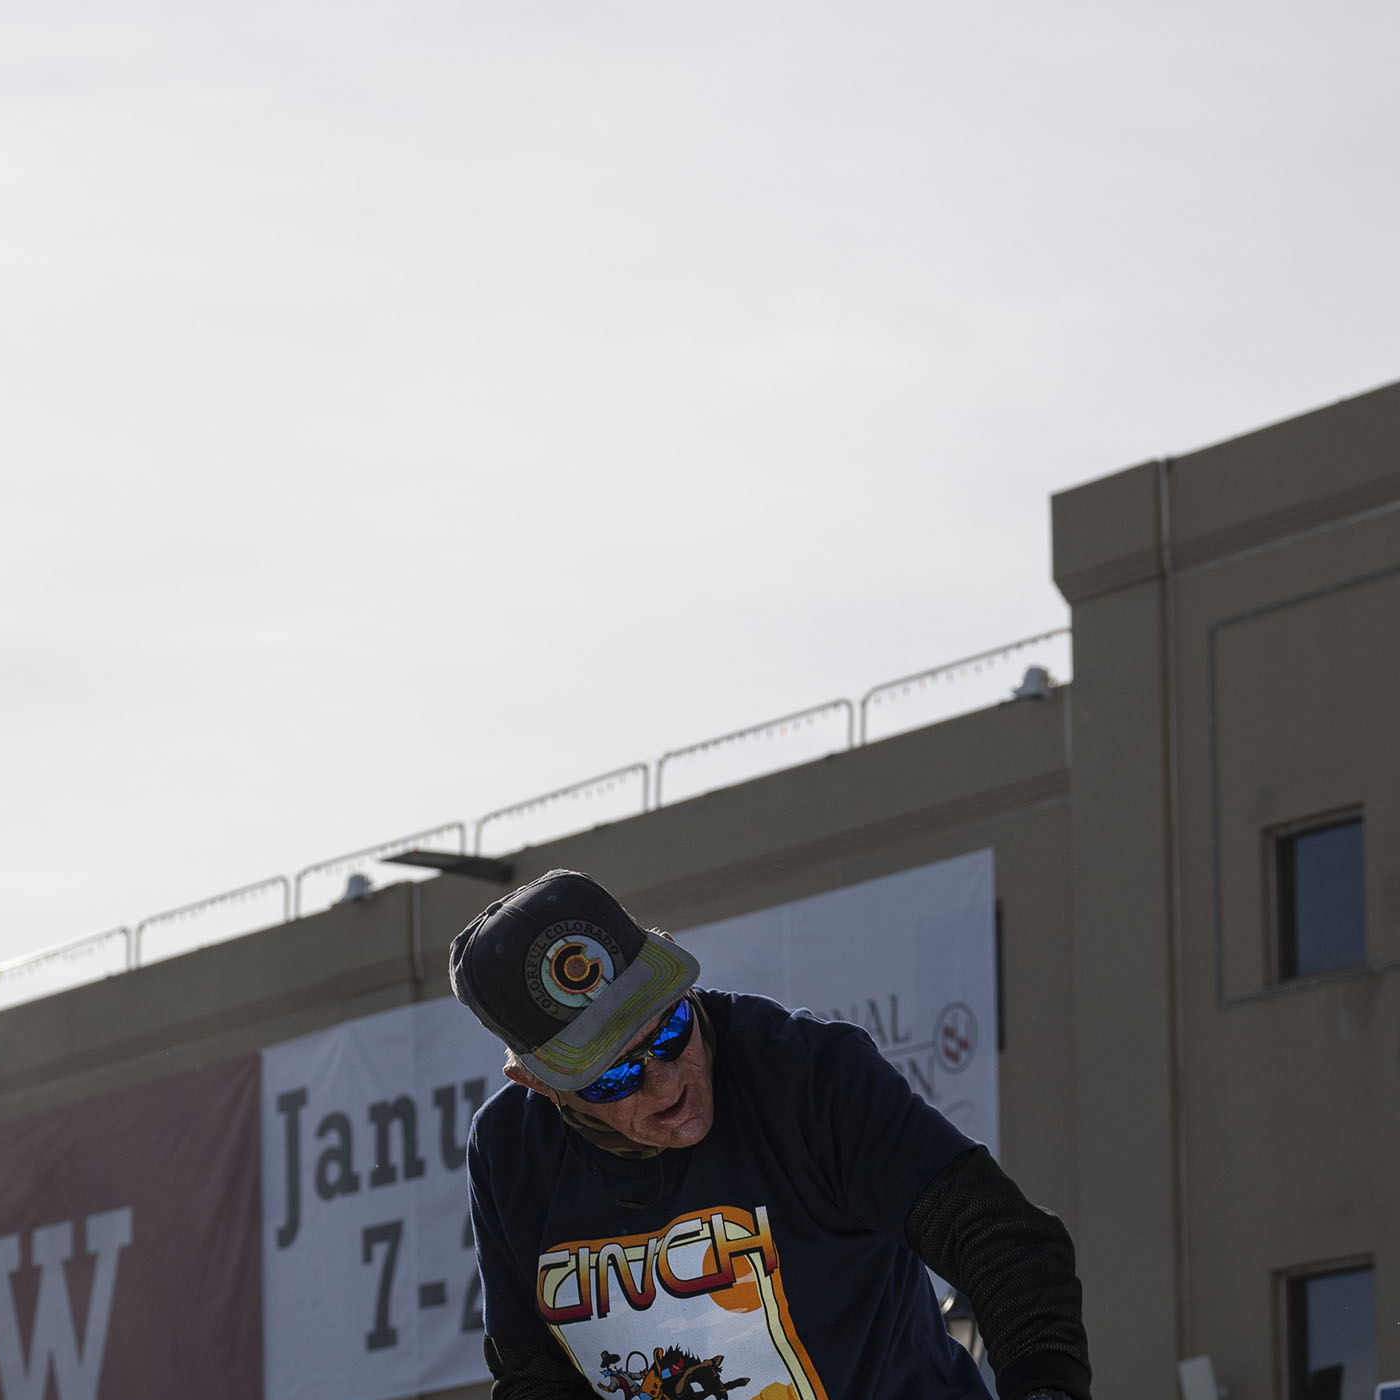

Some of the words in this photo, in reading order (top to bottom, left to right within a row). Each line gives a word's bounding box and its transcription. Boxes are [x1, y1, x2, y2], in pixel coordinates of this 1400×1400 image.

[526, 940, 561, 1016] COLORFUL
[544, 920, 620, 956] COLORADO
[537, 1205, 778, 1324] CINCH
